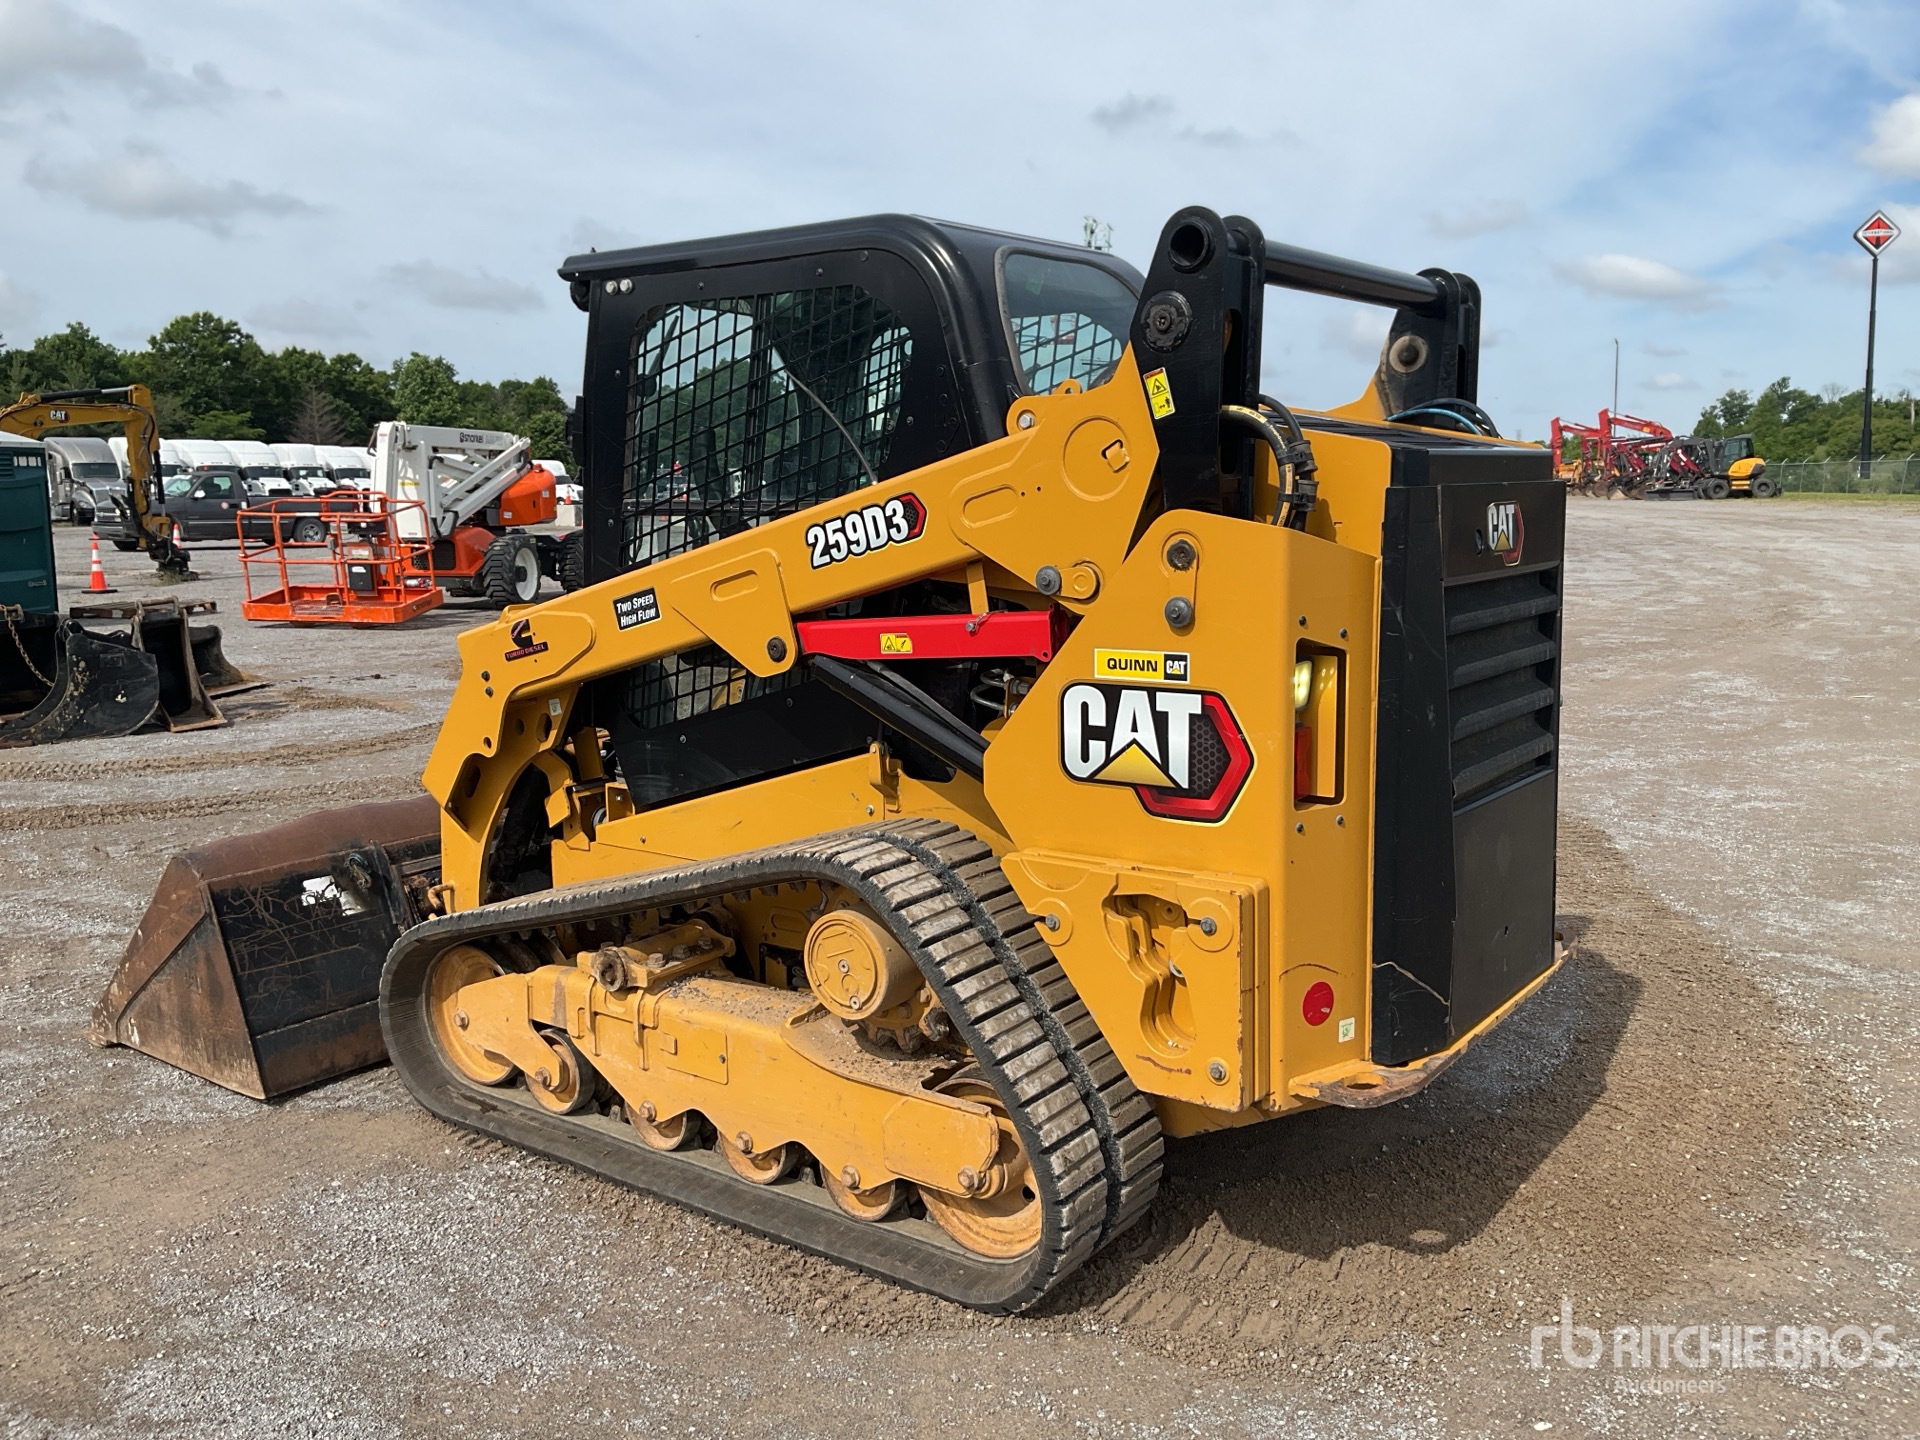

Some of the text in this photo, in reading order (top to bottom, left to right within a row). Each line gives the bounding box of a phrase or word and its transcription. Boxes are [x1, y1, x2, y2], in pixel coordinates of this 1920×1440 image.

[50, 410, 66, 420] CAT
[806, 499, 909, 567] 259D3
[1488, 504, 1515, 551] CAT
[1107, 657, 1158, 672] QUINN
[1165, 660, 1187, 675] CAT
[1063, 684, 1202, 789] CAT
